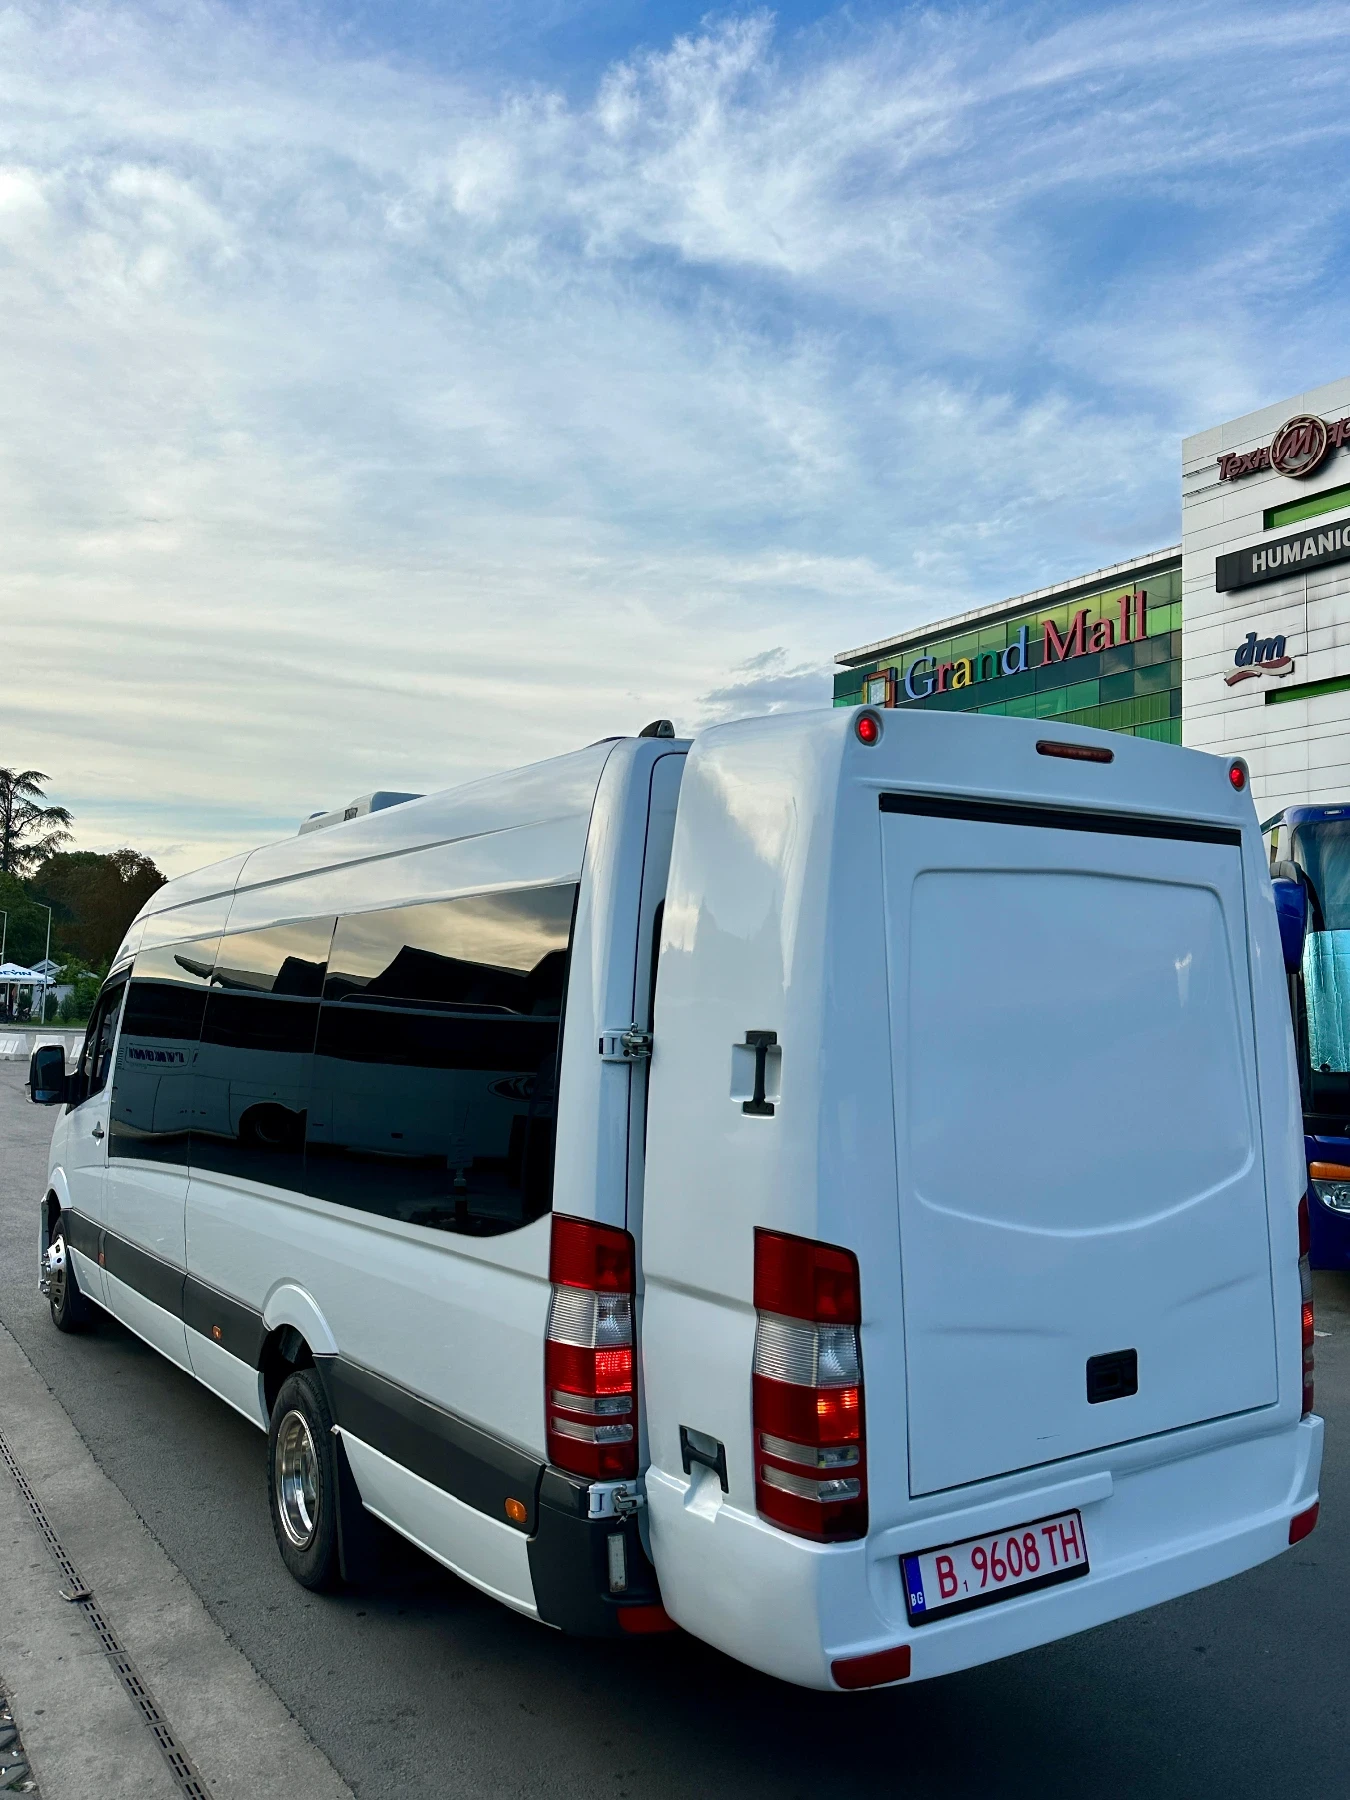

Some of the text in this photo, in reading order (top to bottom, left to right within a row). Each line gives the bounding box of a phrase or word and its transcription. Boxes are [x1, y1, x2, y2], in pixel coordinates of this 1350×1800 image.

[904, 590, 1148, 699] Grand Mall
[1234, 632, 1286, 667] dm
[935, 1555, 958, 1599] B
[971, 1532, 1040, 1588] 9608
[1042, 1520, 1080, 1566] TH
[911, 1592, 924, 1606] BG
